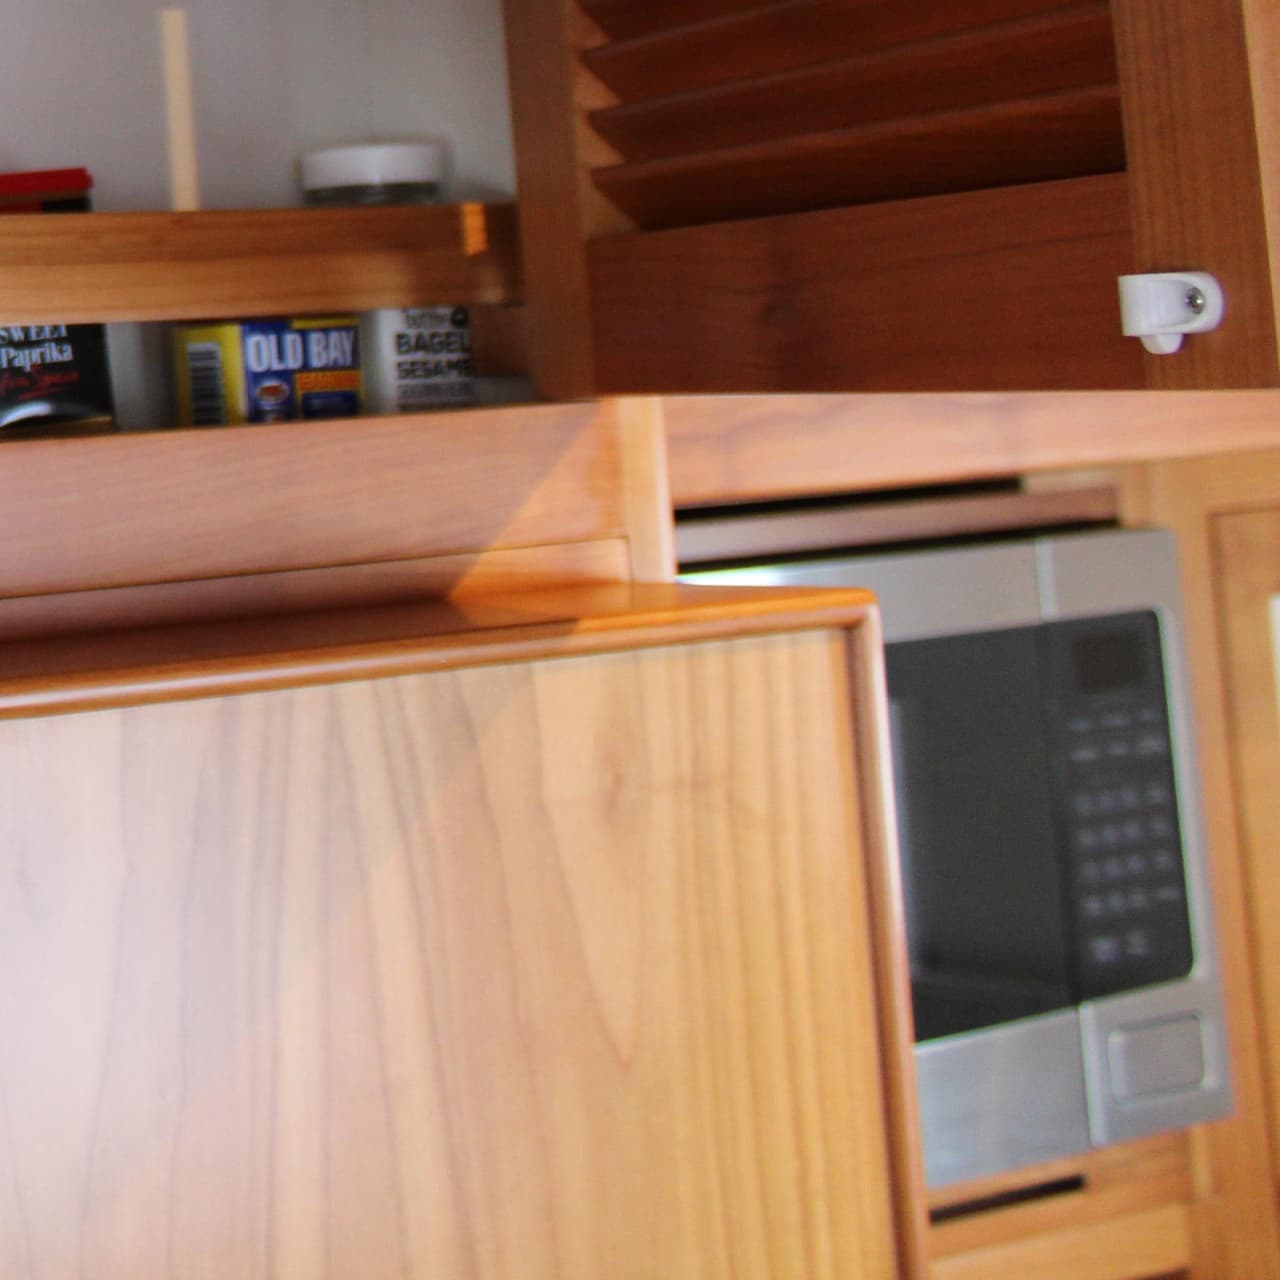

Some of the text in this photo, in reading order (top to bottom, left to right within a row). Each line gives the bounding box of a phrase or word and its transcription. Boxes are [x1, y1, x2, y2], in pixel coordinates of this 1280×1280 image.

[245, 329, 354, 373] OLD BAY
[395, 330, 471, 355] BAGEL
